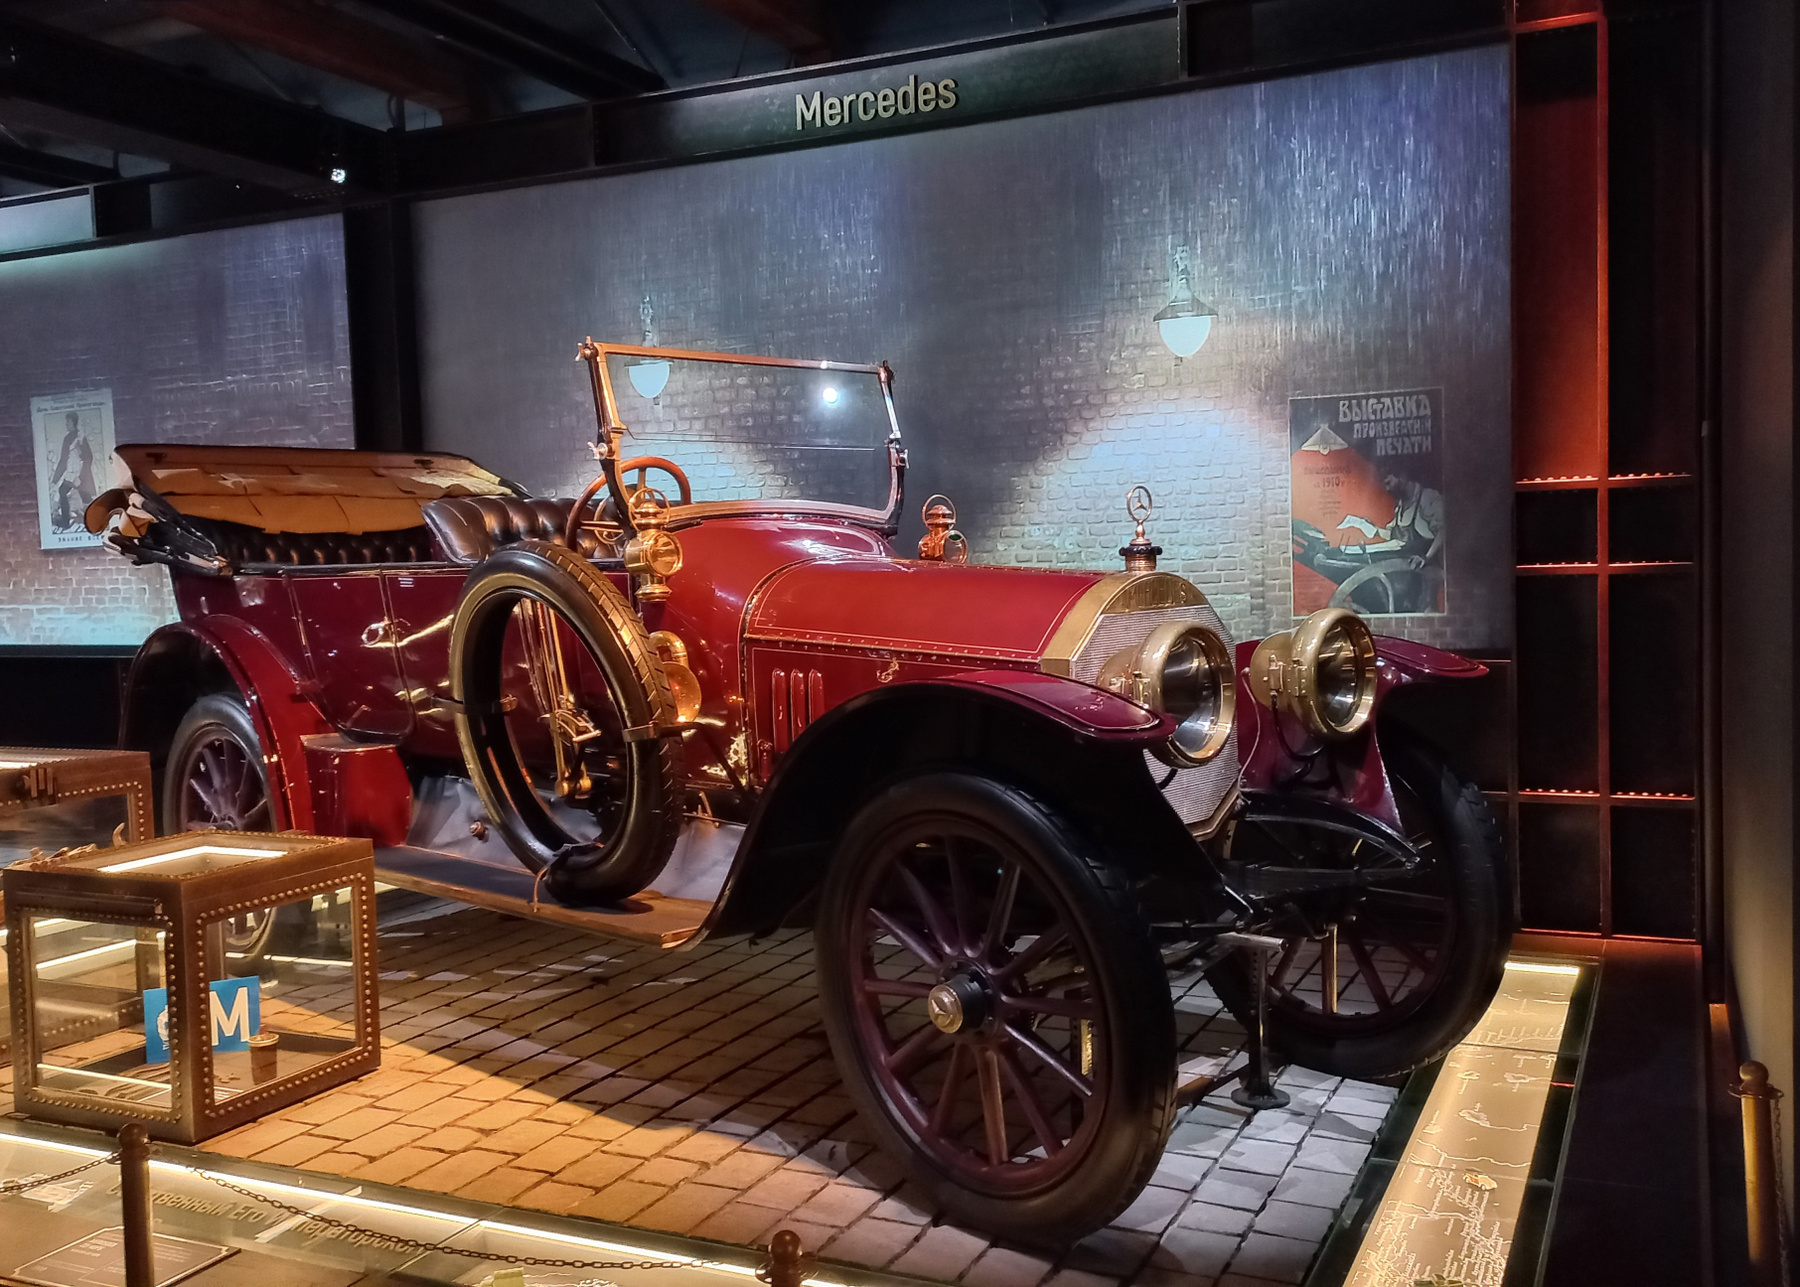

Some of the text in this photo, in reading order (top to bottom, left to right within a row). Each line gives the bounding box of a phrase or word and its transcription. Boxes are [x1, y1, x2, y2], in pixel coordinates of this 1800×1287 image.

[795, 74, 957, 131] Mercedes
[1339, 394, 1432, 423] ВЫСТАВКА
[1376, 435, 1432, 457] ПЕЧАТИ
